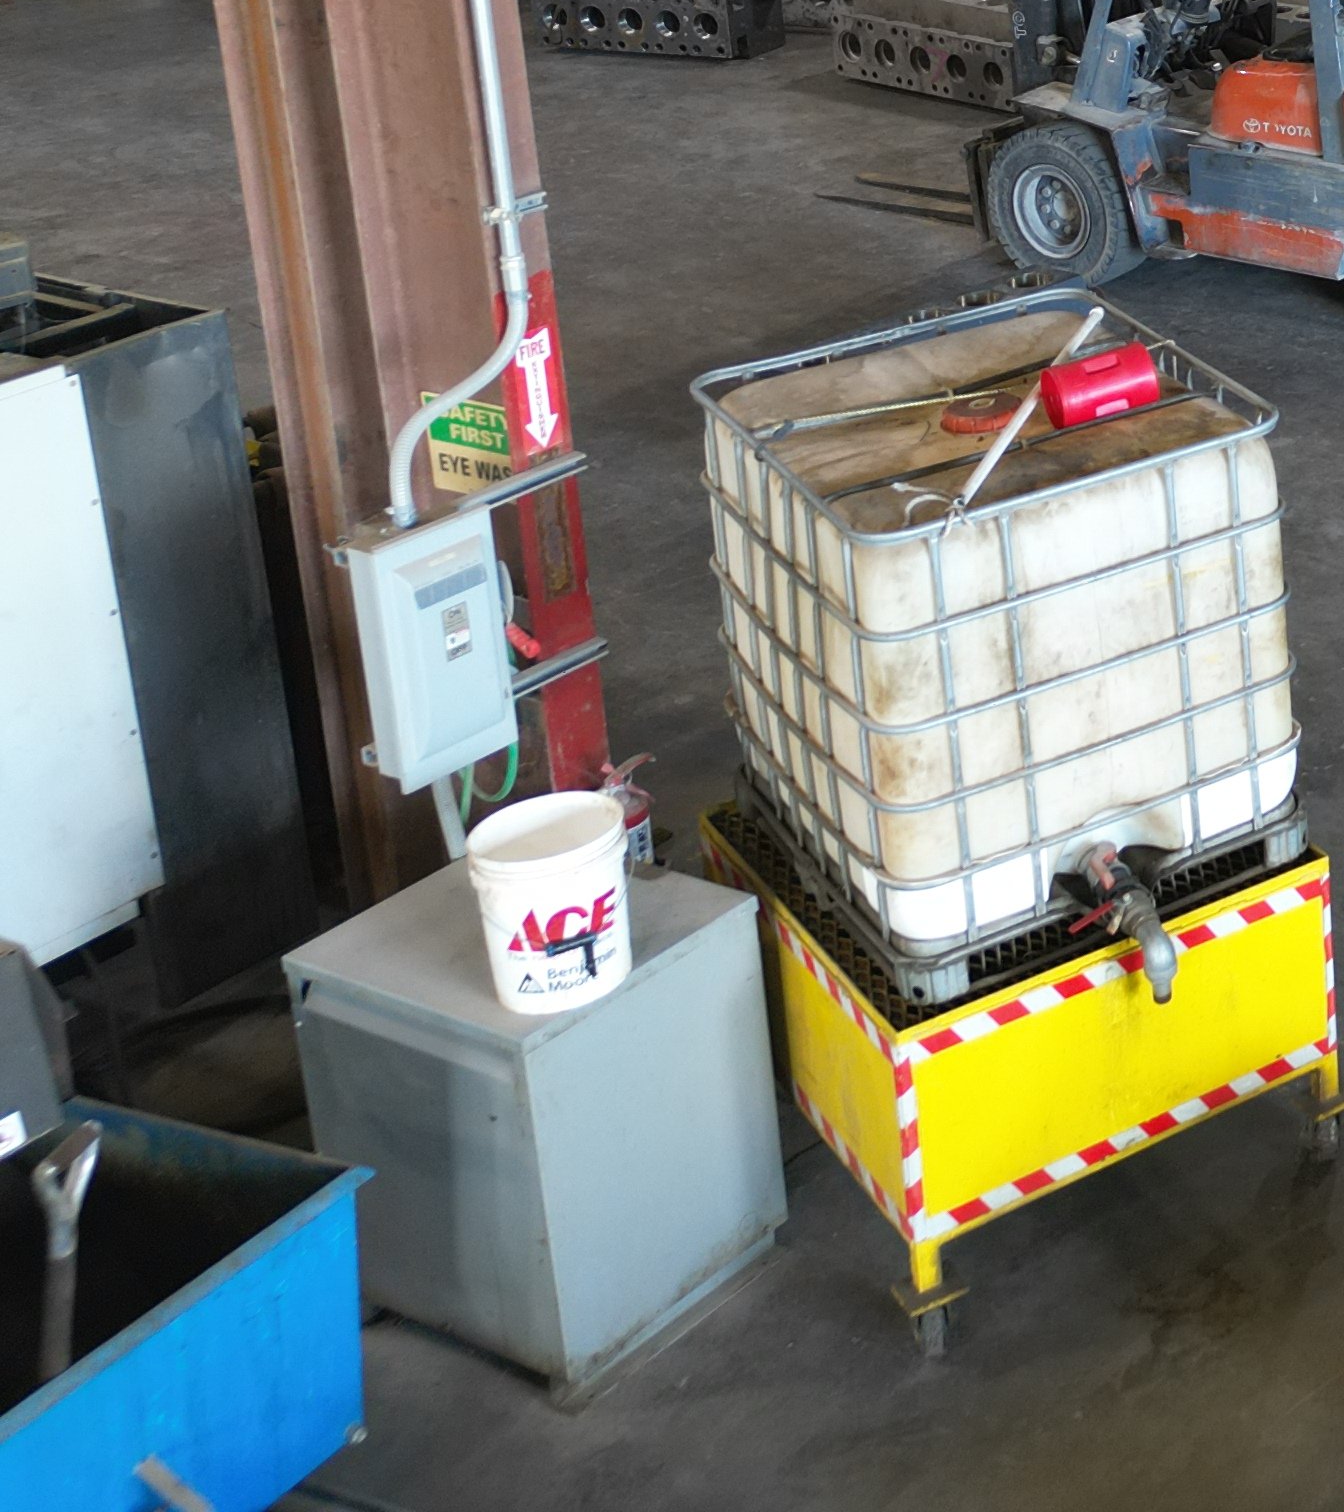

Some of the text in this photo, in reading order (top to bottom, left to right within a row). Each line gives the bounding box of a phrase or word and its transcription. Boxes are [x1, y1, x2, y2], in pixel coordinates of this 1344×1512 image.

[520, 339, 545, 361] FIRE
[448, 423, 504, 449] FIRST
[439, 453, 513, 482] EYE WAS
[507, 887, 616, 952] ACE
[547, 947, 616, 979] Benjmin
